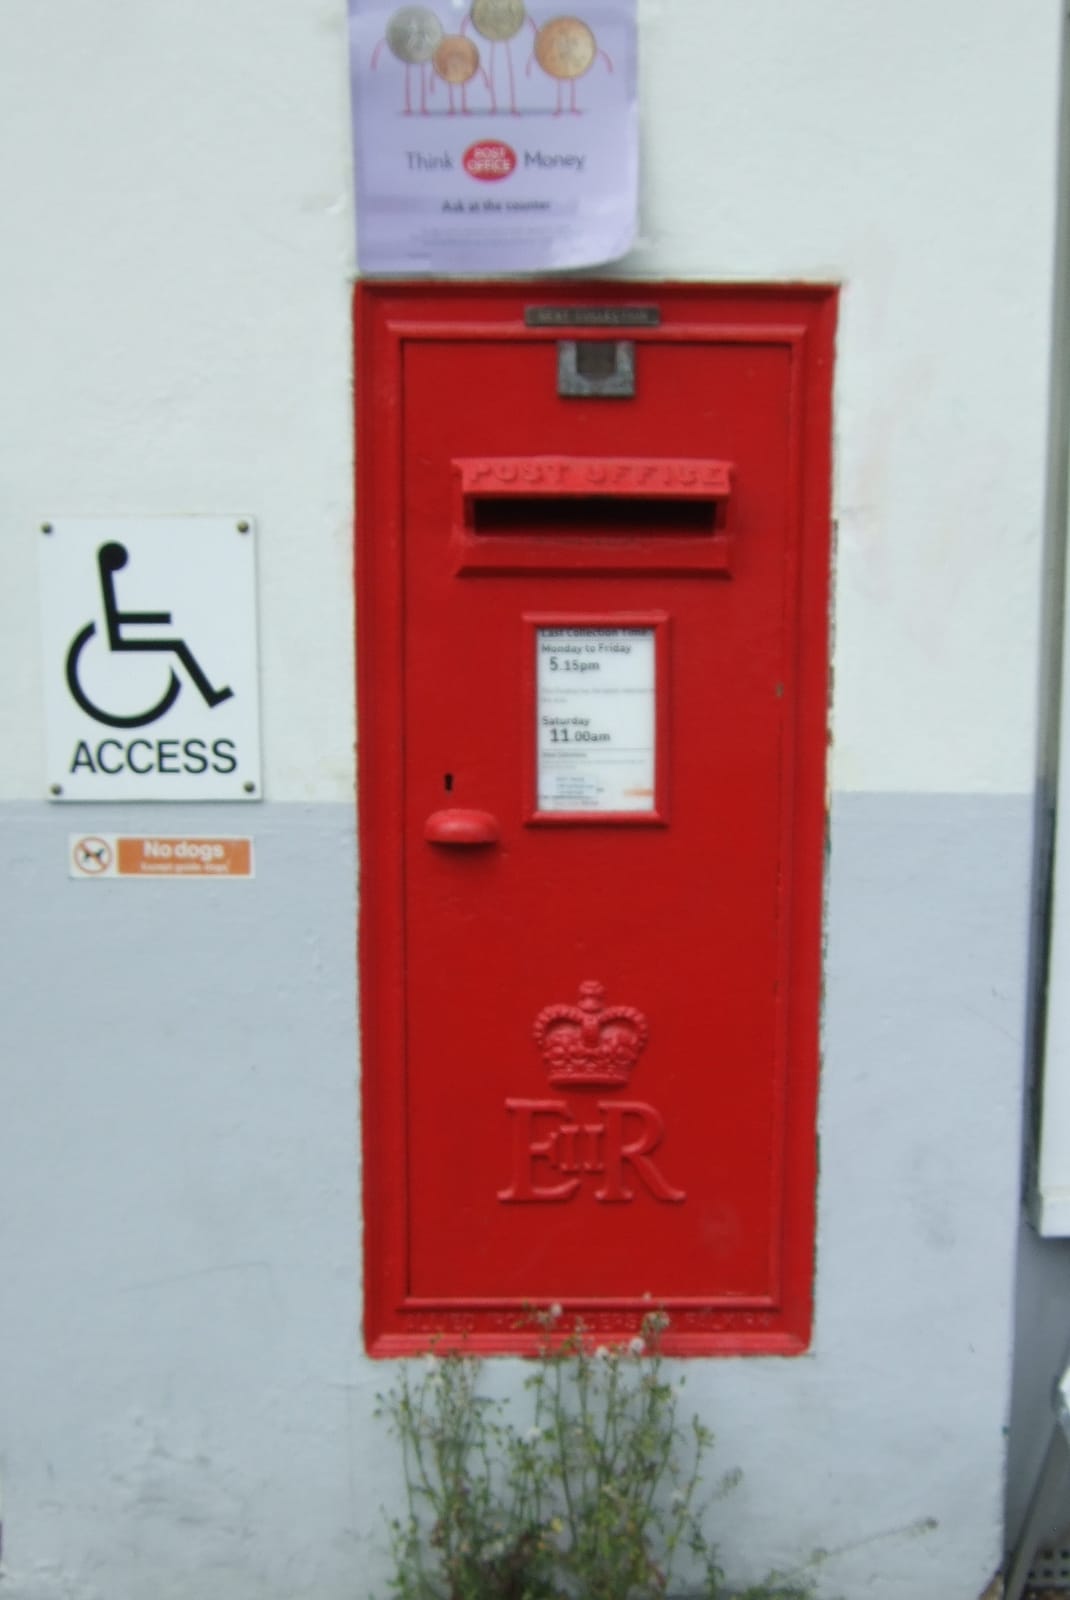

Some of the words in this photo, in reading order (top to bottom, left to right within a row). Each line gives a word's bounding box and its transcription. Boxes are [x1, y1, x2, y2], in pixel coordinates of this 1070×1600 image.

[407, 150, 454, 171] Think
[523, 150, 585, 172] Money
[472, 146, 506, 159] POST
[466, 158, 512, 172] OFFICE
[470, 463, 570, 485] POST
[584, 464, 727, 487] OFFICE
[541, 643, 582, 655] Monday
[584, 643, 596, 653] to
[598, 642, 632, 655] Friday
[542, 715, 590, 727] Saturday
[69, 738, 237, 775] ACCESS
[143, 840, 173, 858] No
[174, 840, 225, 863] dogs
